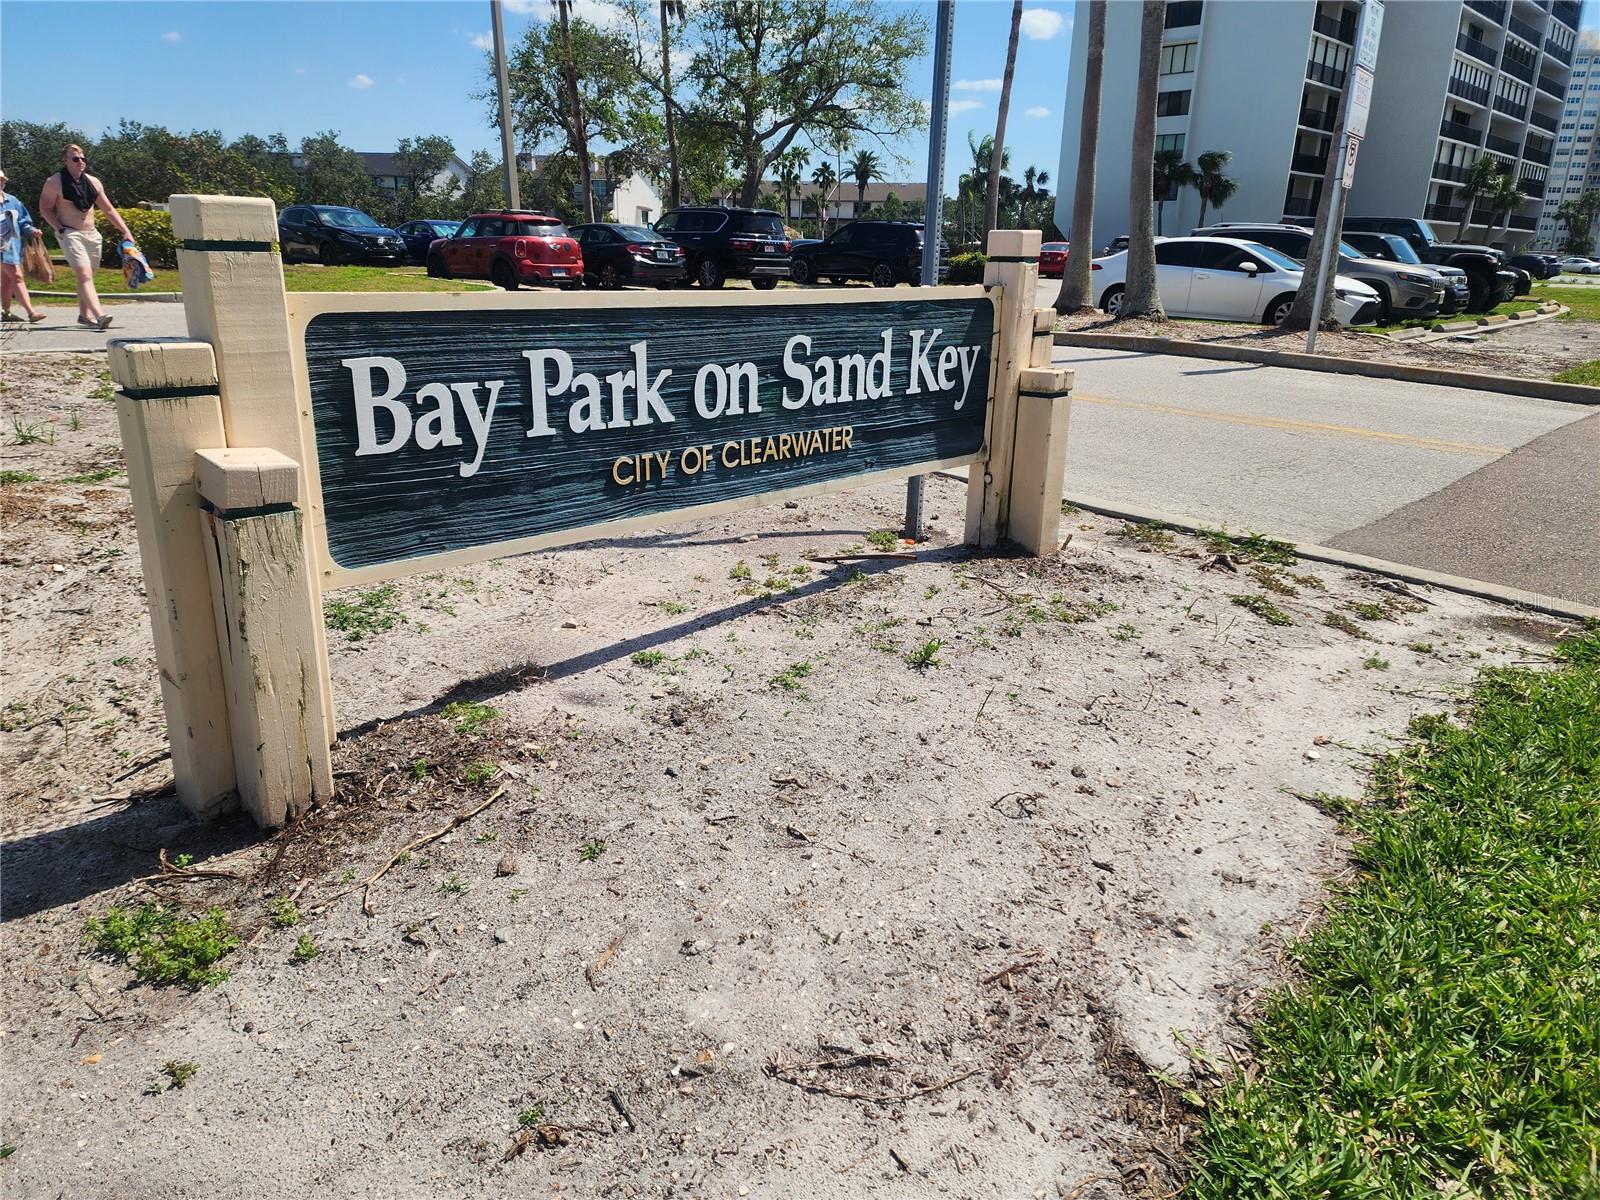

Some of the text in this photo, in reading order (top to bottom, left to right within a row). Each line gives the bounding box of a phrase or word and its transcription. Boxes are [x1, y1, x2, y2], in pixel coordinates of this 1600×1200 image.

[341, 327, 981, 478] Bay Park on Sand Key
[612, 426, 854, 486] CITY OF CLEARWATER
